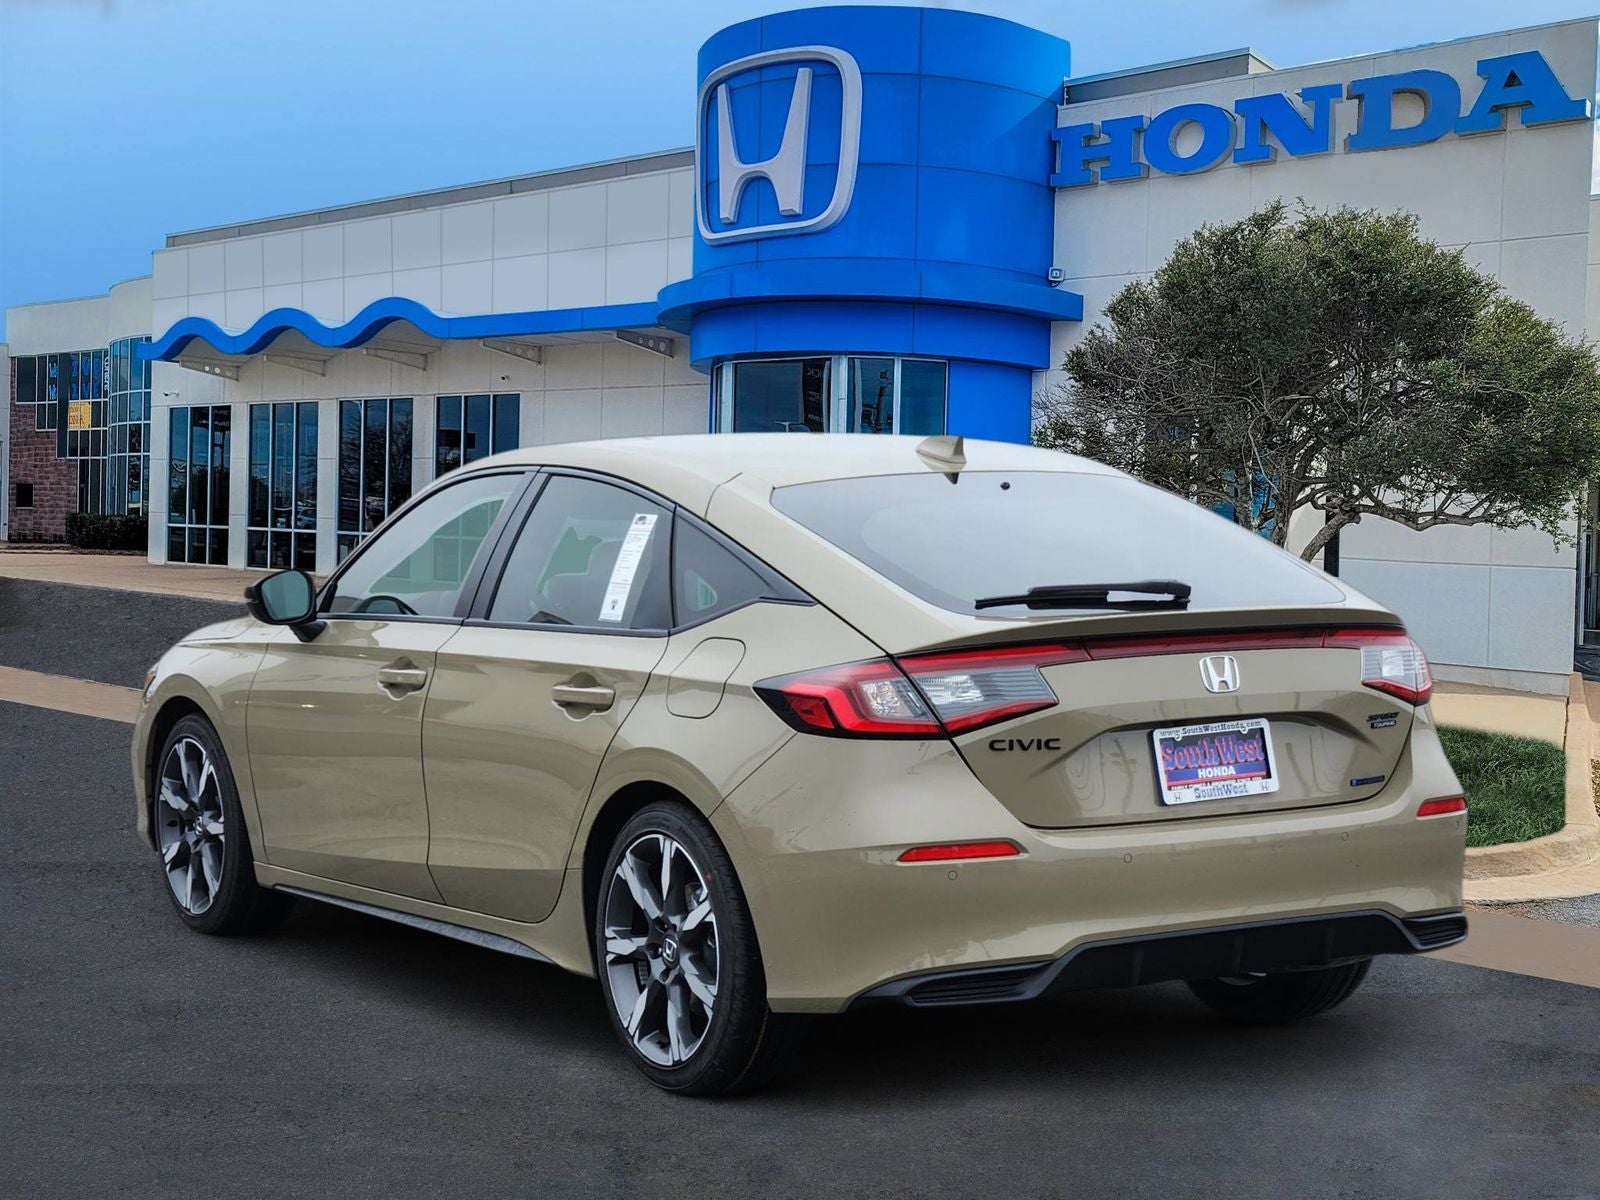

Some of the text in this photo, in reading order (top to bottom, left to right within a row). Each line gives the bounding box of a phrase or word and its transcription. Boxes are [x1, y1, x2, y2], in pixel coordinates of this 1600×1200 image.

[1051, 50, 1591, 187] HONDA
[1160, 720, 1262, 739] www.SouthWestHonda.com
[988, 738, 1061, 752] CIVIC
[1161, 733, 1264, 771] SouthWest
[1197, 765, 1236, 779] HONDA
[1195, 784, 1248, 799] SouthWest
